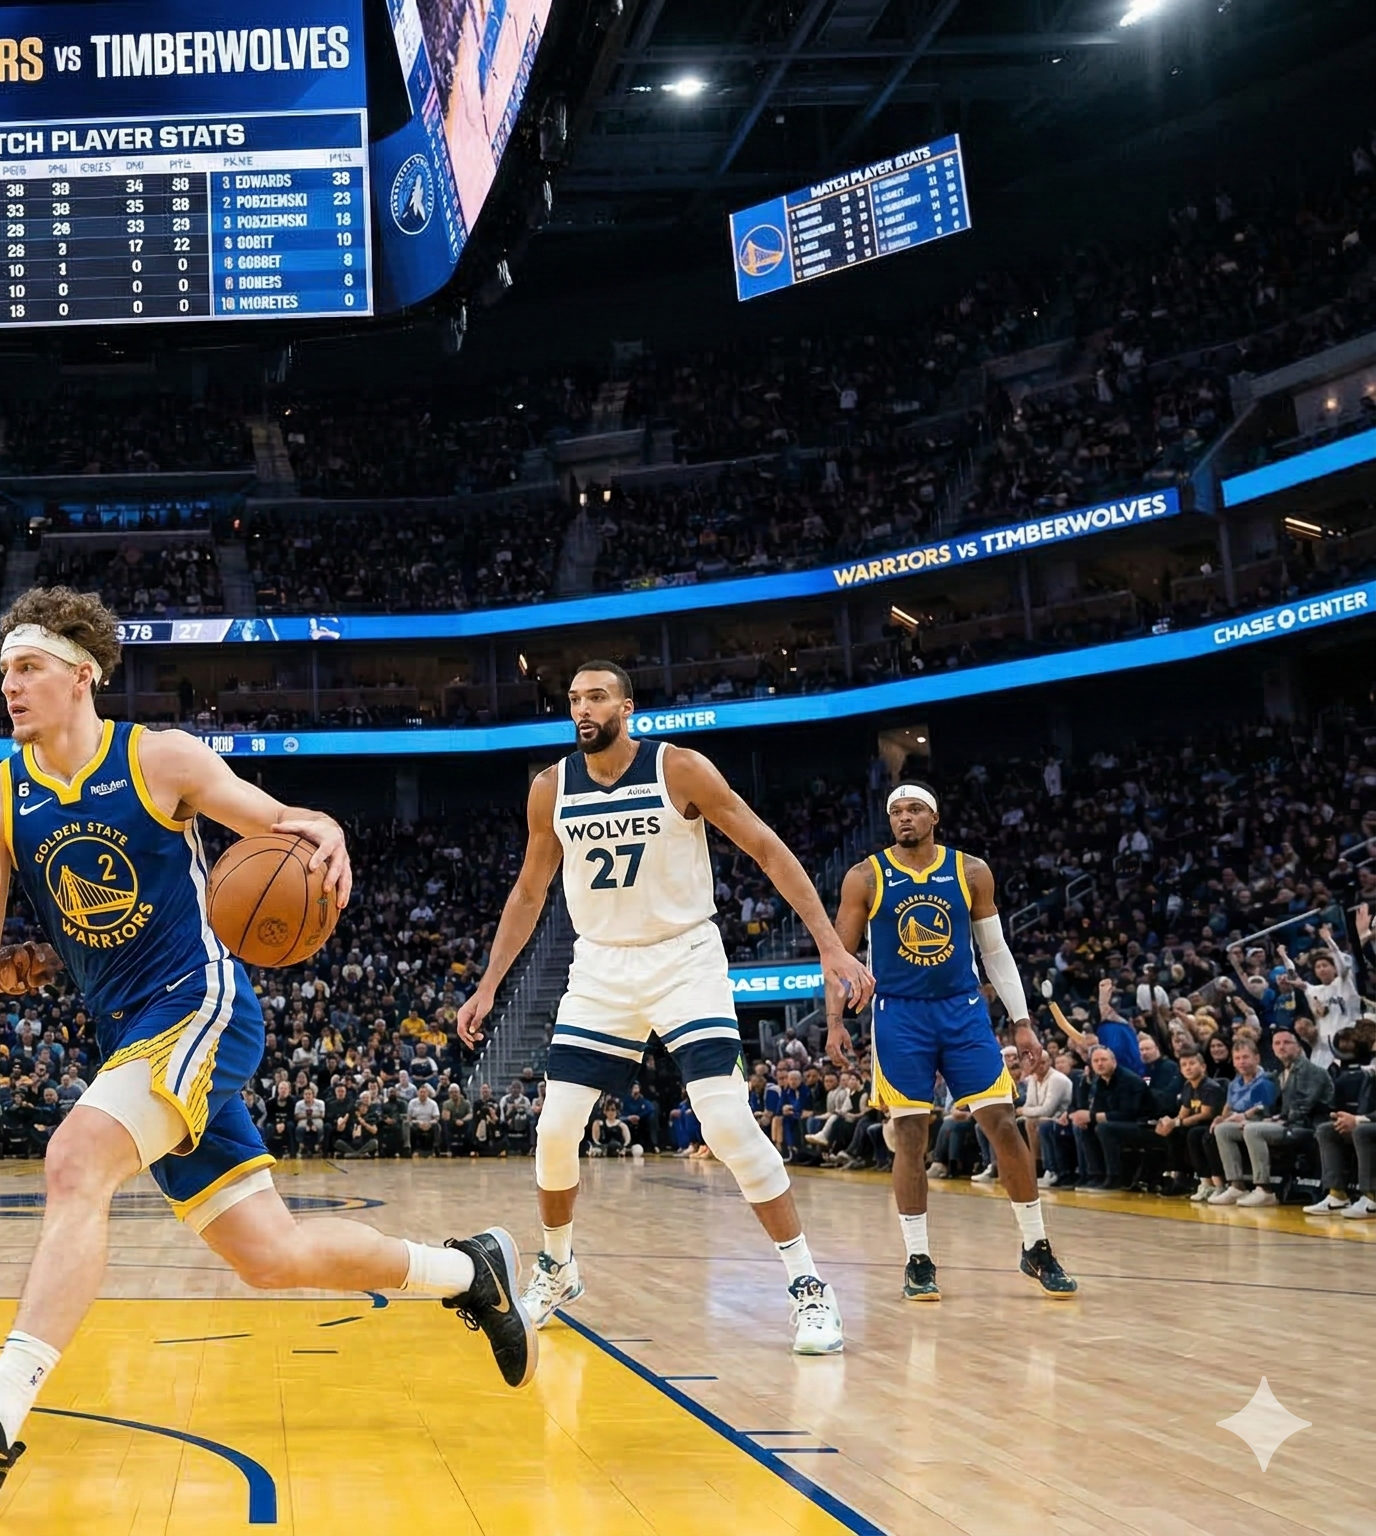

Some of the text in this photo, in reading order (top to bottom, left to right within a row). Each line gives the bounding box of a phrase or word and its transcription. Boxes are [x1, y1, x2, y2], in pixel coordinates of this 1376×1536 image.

[90, 26, 350, 78] TIMBERWOLVES
[51, 128, 154, 153] PLAYER
[159, 124, 246, 148] STATS
[125, 179, 144, 192] 34
[332, 172, 351, 186] 38
[125, 199, 145, 213] 35
[222, 196, 231, 209] 2
[332, 192, 352, 205] 23
[335, 212, 352, 226] 18
[128, 239, 144, 252] 17
[8, 264, 25, 277] 10
[131, 259, 142, 272] 0
[177, 258, 188, 271] 0
[8, 284, 25, 298] 10
[58, 283, 69, 296] 0
[132, 280, 143, 293] 0
[178, 278, 189, 292] 0
[58, 303, 69, 316] 0
[132, 300, 143, 313] 0
[179, 298, 190, 312] 0
[344, 293, 355, 307] 0
[833, 545, 952, 587] WARRIORS
[981, 495, 1167, 552] TIMBERWOLVES
[1213, 591, 1368, 644] CHASE CENTER
[655, 710, 716, 730] CENTER
[18, 781, 30, 797] 6
[565, 816, 661, 842] WOLVES
[35, 822, 128, 864] GOLDEN STATE
[98, 854, 117, 881] 2
[585, 843, 645, 889] 27
[61, 902, 154, 948] WARRIORS
[933, 911, 944, 929] 4
[729, 974, 824, 992] ASE CENT
